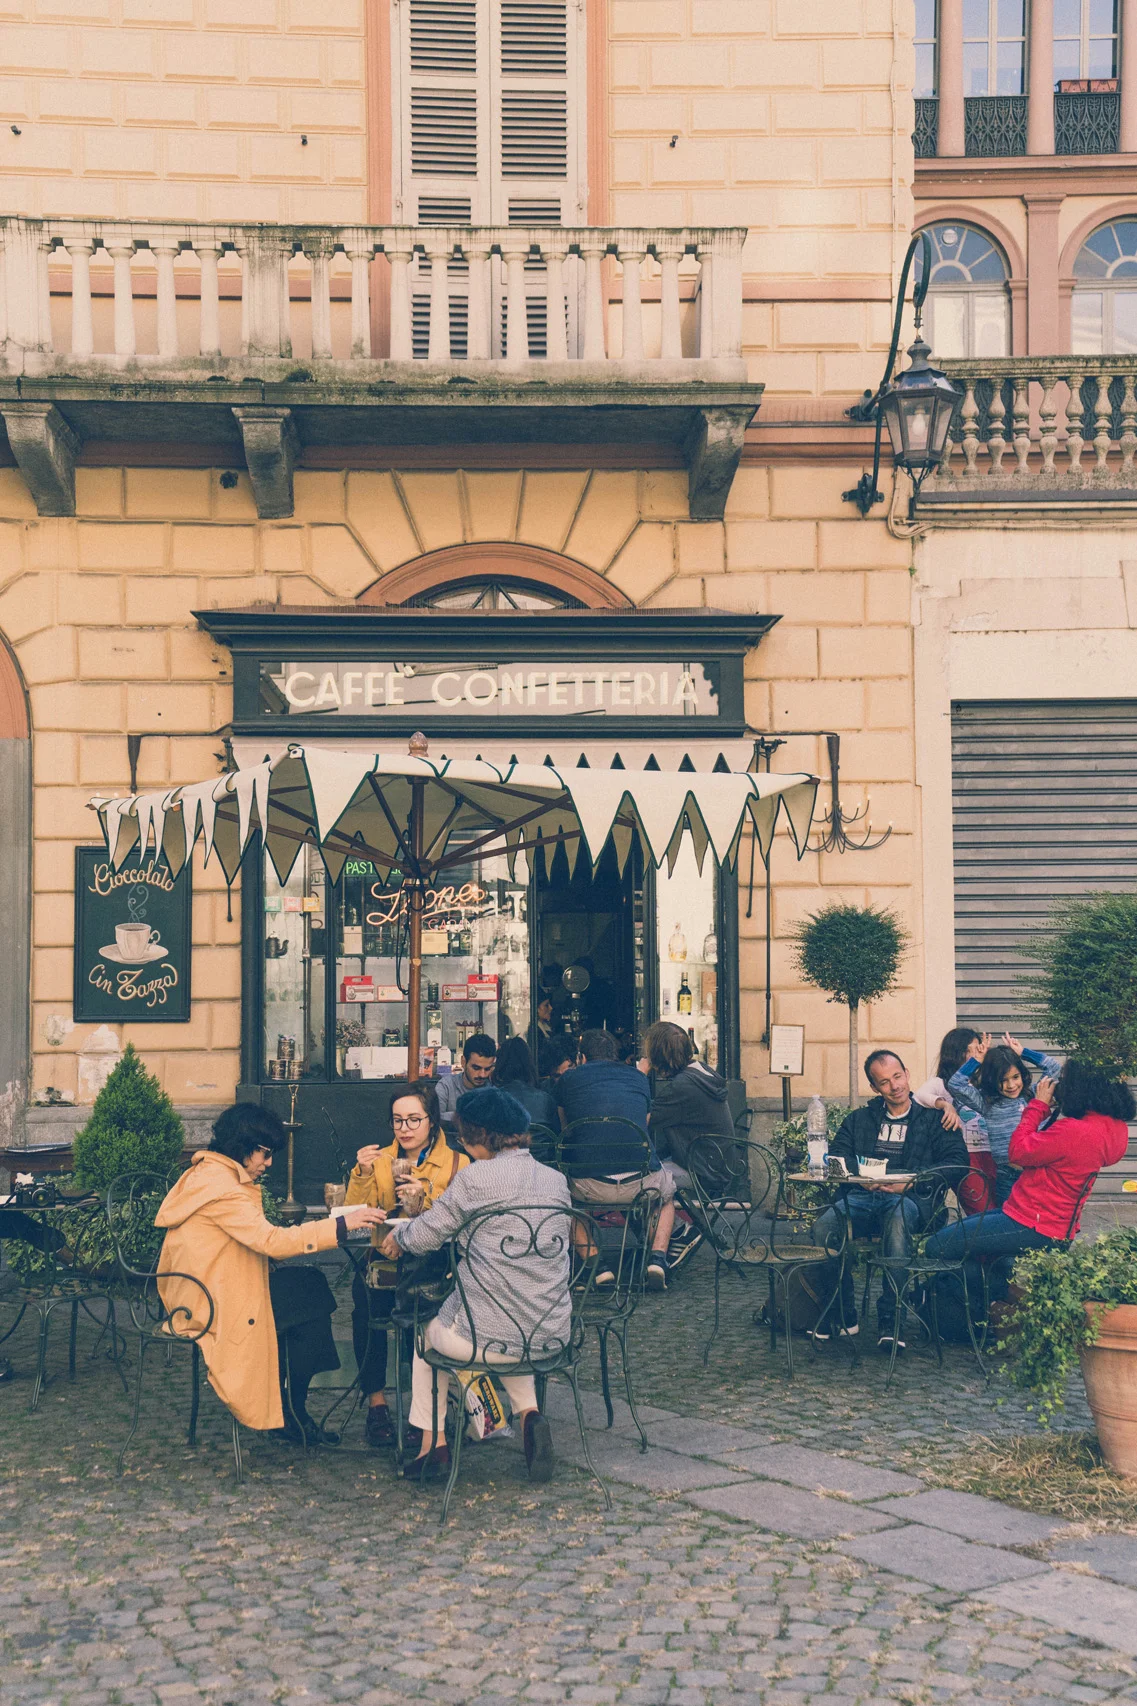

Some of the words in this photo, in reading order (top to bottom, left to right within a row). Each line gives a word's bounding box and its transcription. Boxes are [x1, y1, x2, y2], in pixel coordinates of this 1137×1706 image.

[431, 671, 699, 707] CONFETTERIA
[88, 860, 175, 896] Cioccolato
[89, 964, 113, 995] in
[117, 964, 179, 1008] Tazza
